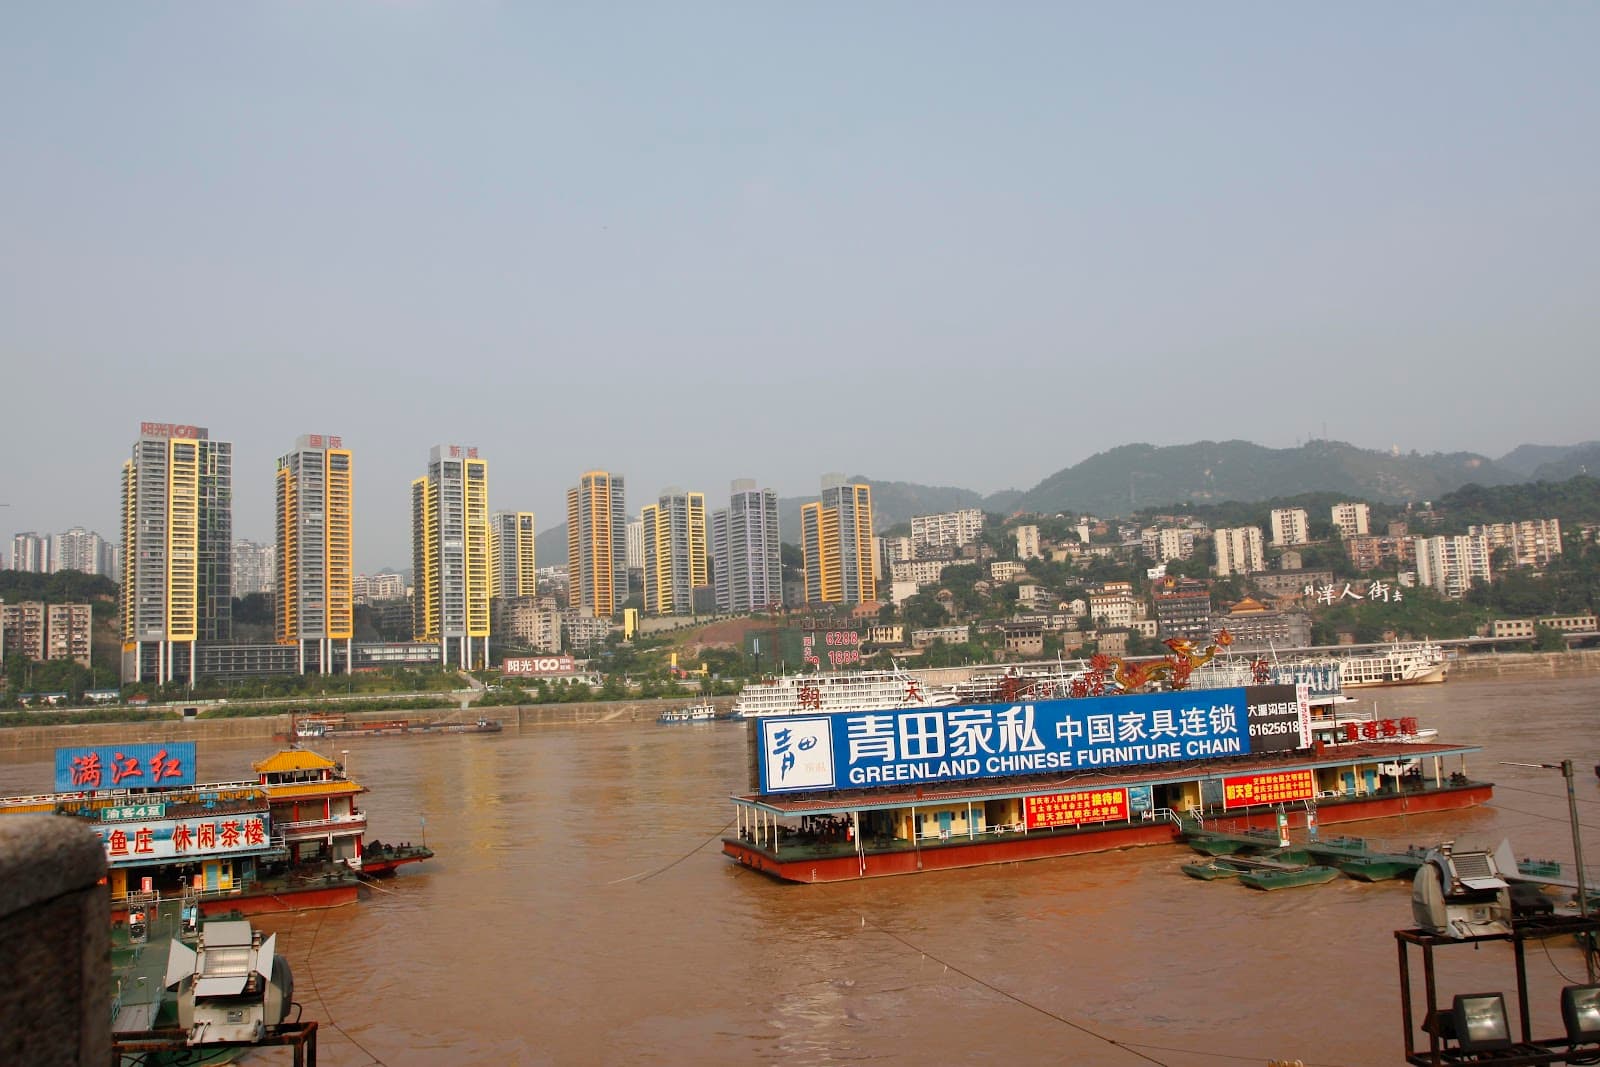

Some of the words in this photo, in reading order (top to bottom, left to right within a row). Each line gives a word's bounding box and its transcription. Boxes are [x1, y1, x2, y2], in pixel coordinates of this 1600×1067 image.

[310, 434, 342, 449] 国际
[826, 631, 858, 645] 6288
[507, 658, 560, 672] 阳光100
[828, 650, 859, 665] 1888
[847, 705, 1046, 764] 青田家私
[1055, 703, 1238, 748] 中国家具连锁
[1249, 720, 1300, 737] 61625618
[69, 749, 182, 788] 满江红
[849, 759, 981, 785] GREENLAND
[986, 749, 1072, 774] CHINESE
[1077, 741, 1182, 767] FURNITURE
[1186, 736, 1241, 756] CHAIN
[97, 827, 154, 856] 鱼庄
[172, 818, 265, 852] 休闲茶楼
